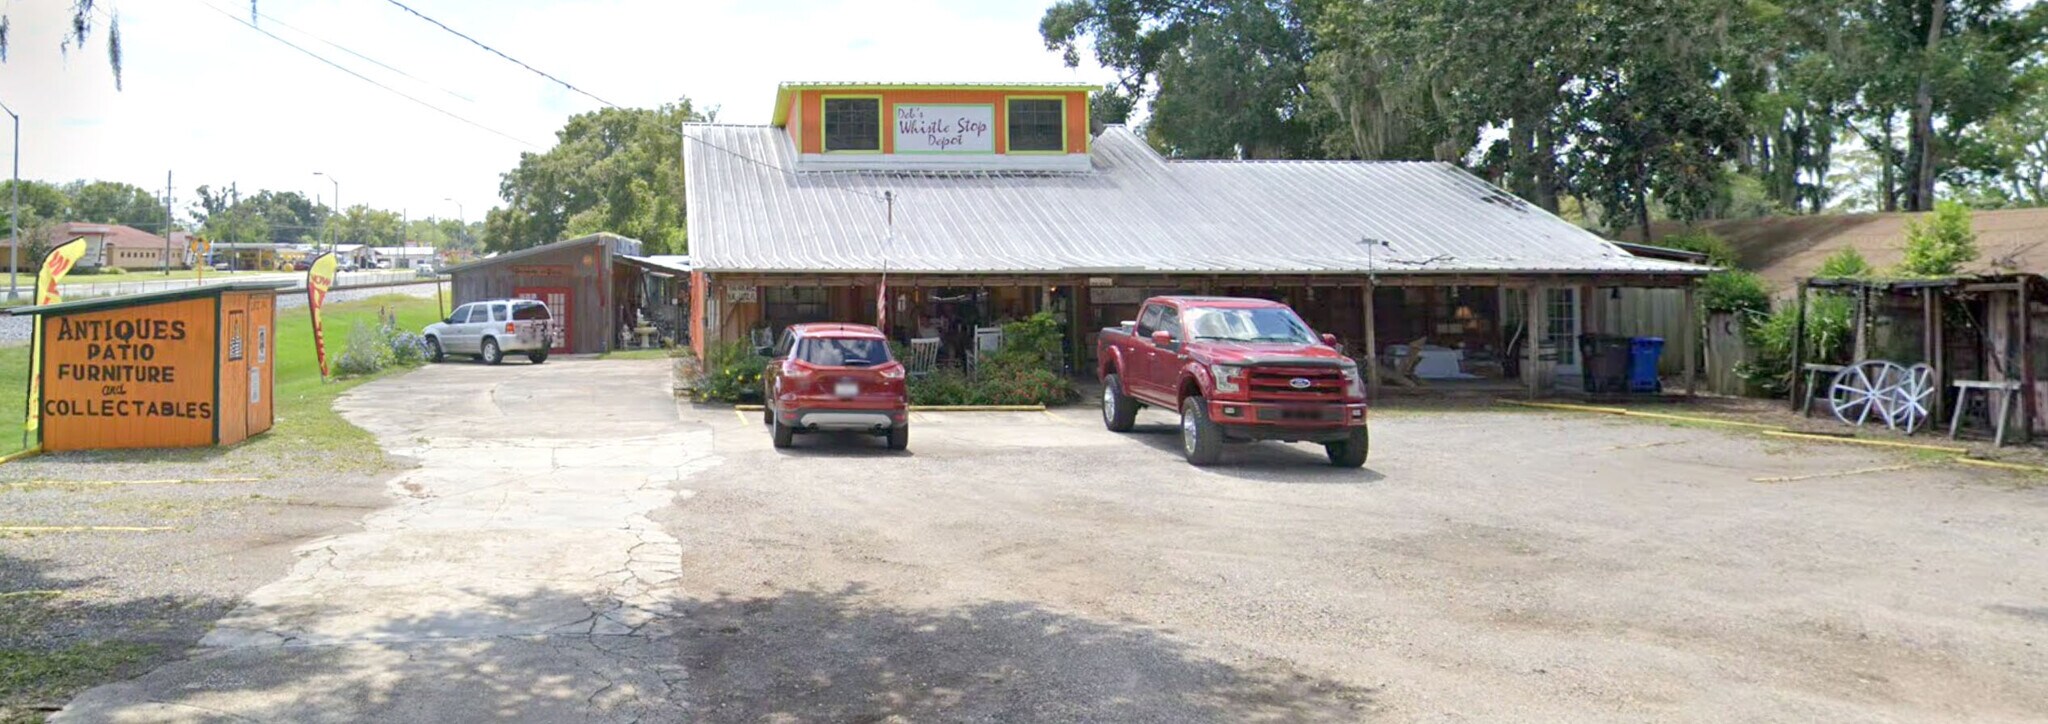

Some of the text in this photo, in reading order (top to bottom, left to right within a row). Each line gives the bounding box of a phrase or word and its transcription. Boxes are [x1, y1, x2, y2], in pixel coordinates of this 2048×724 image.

[897, 107, 923, 119] Deb's
[899, 117, 987, 137] Whistle Stop
[928, 134, 962, 150] Depot
[57, 317, 186, 343] ANTIQUES
[87, 343, 155, 361] PATIO
[58, 363, 175, 383] FURNITURE
[102, 383, 127, 396] and
[45, 399, 212, 419] COLLECTABLES
